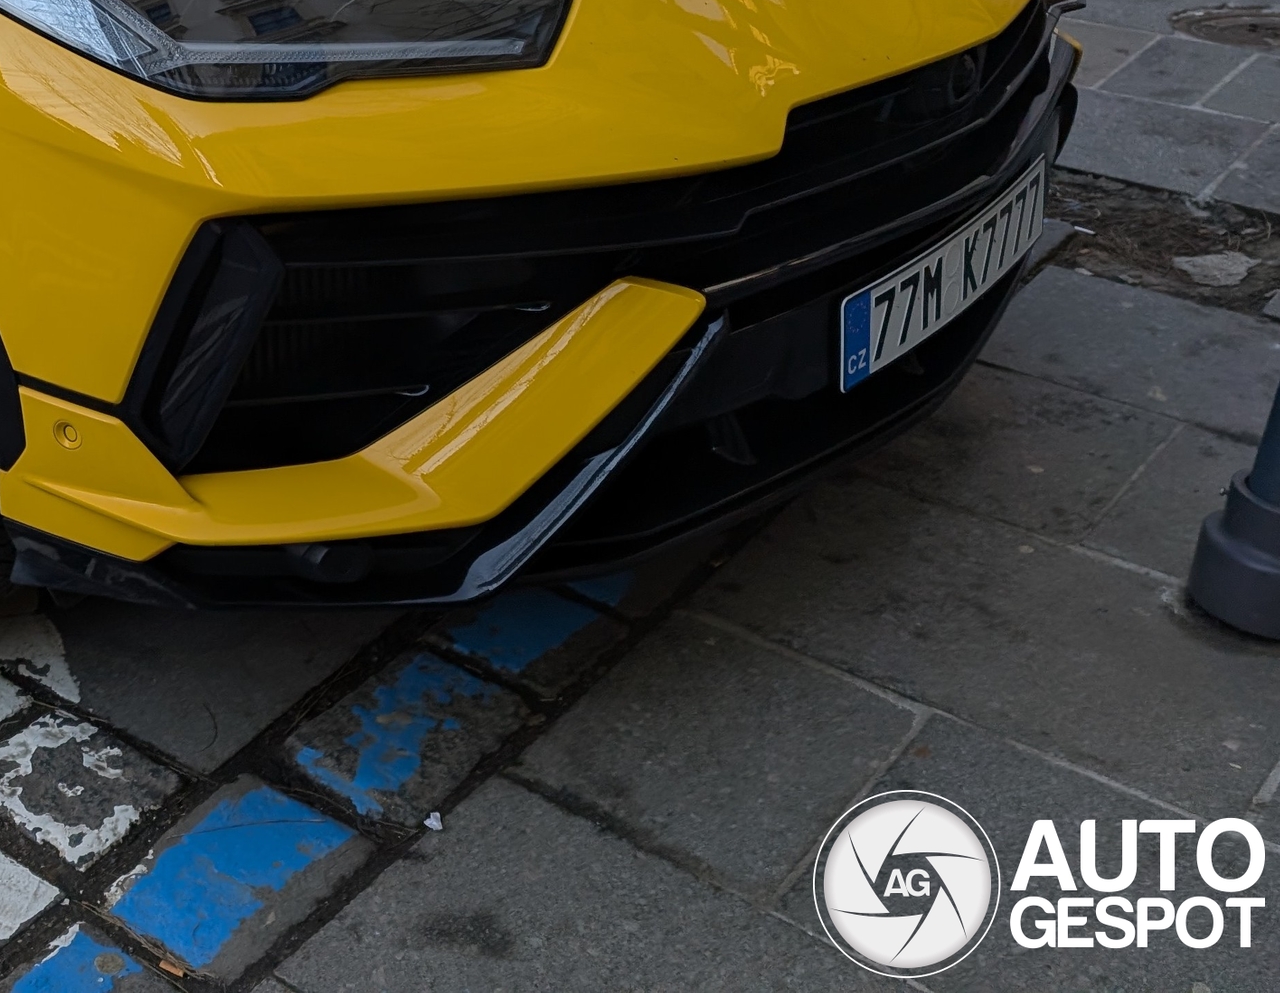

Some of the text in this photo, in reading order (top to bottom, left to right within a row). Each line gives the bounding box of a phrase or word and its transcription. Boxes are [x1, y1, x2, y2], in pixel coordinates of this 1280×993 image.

[872, 170, 1041, 362] 77M K7777
[847, 347, 867, 376] CZ
